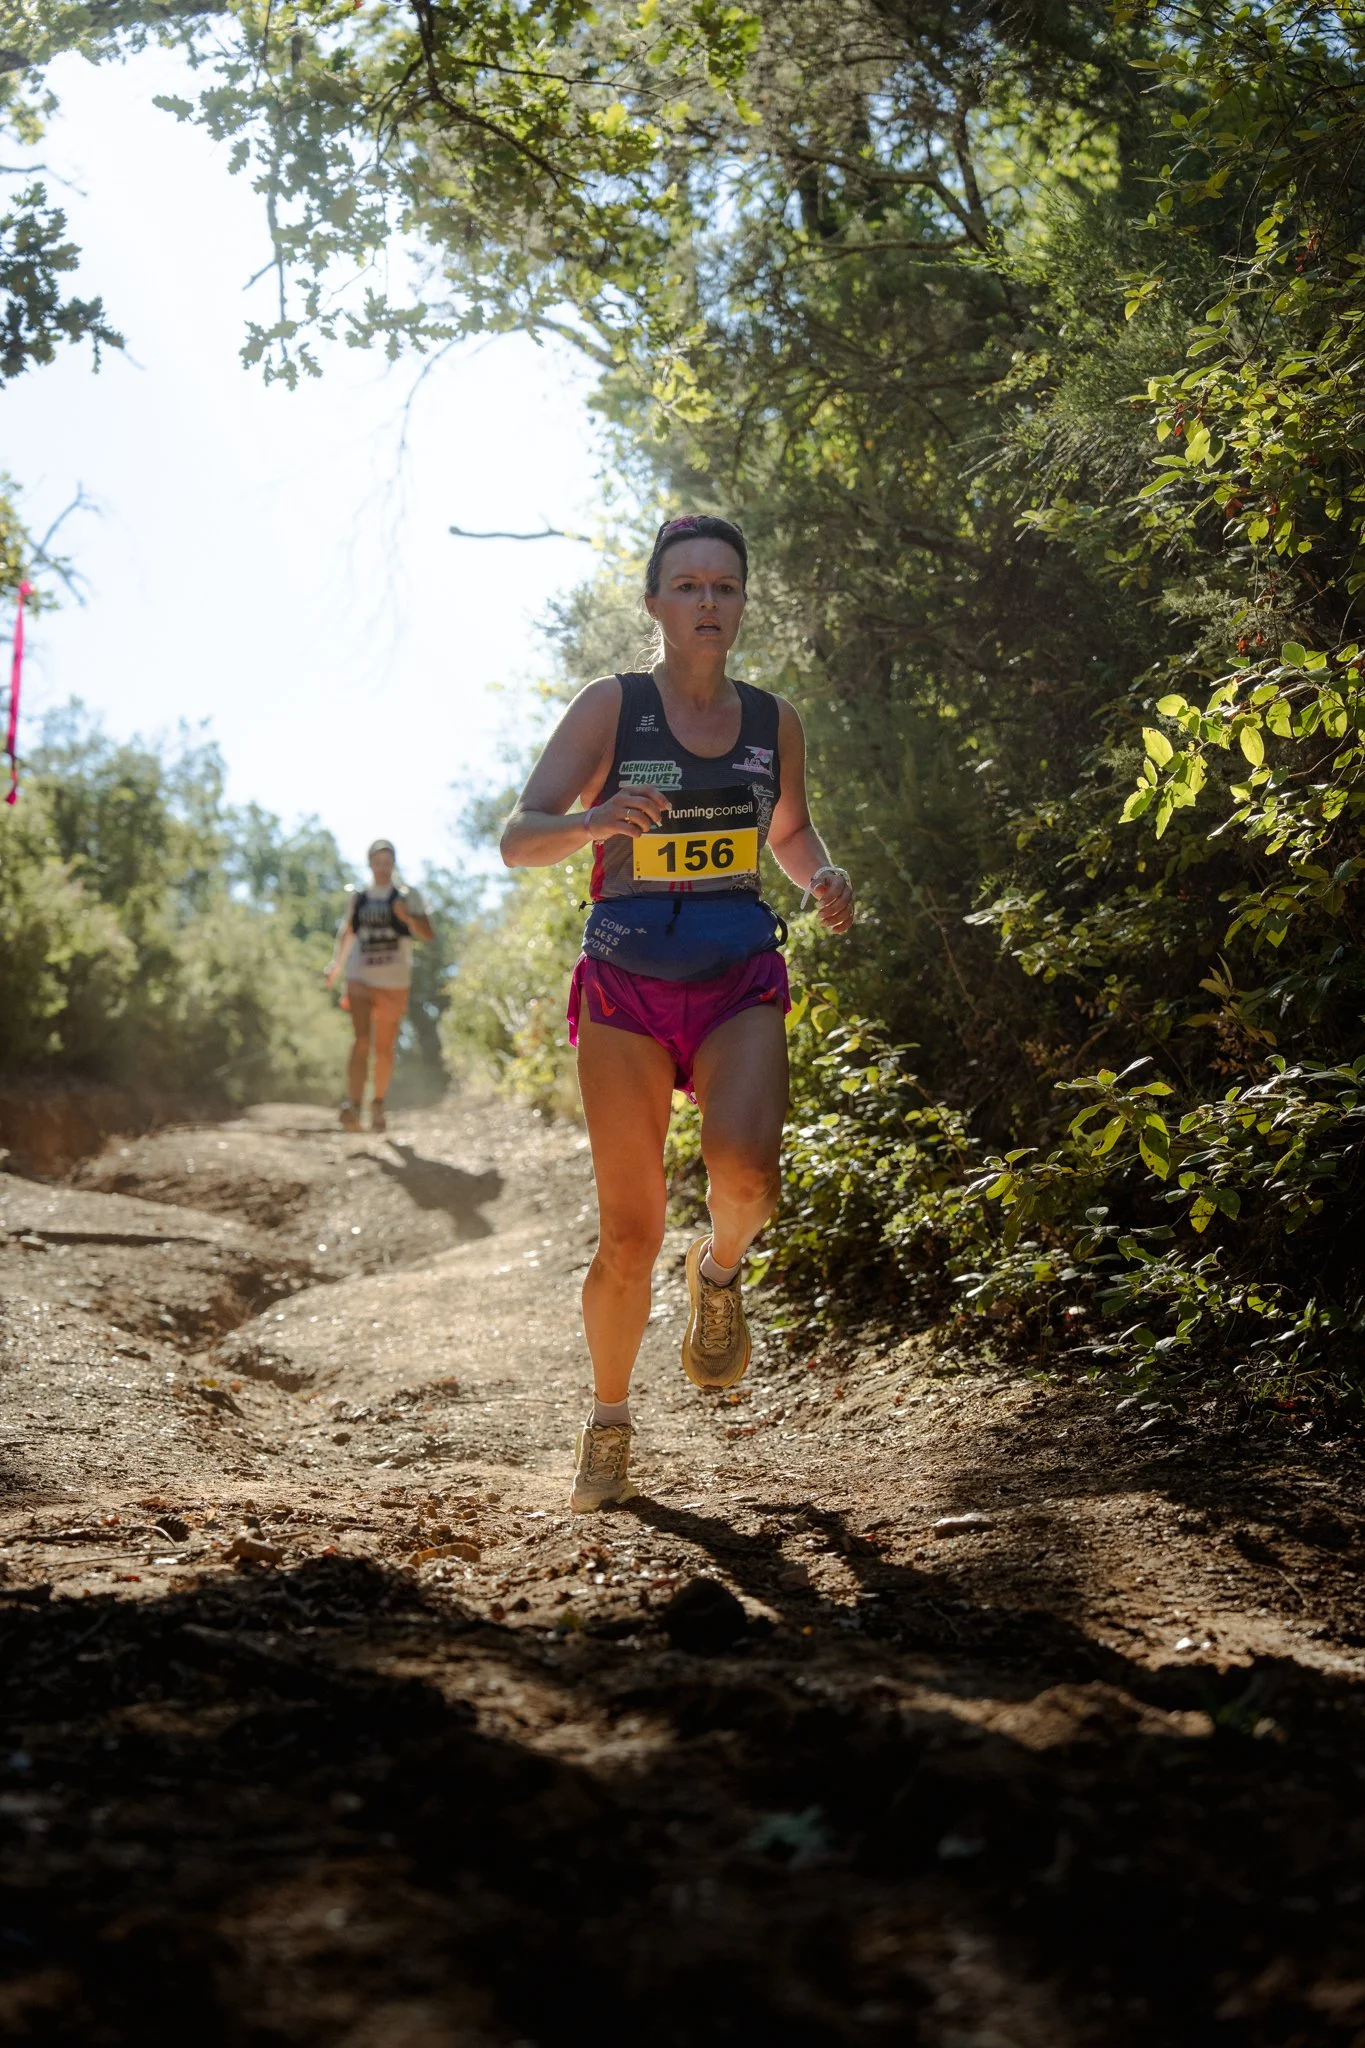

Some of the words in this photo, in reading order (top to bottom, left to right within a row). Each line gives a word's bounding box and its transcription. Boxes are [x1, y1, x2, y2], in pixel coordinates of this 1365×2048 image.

[620, 762, 674, 773] MENUISERIE
[631, 773, 681, 784] FAUVET
[668, 801, 753, 819] runningconseil
[657, 838, 735, 872] 156
[600, 918, 631, 936] COMP
[594, 927, 620, 946] RESS
